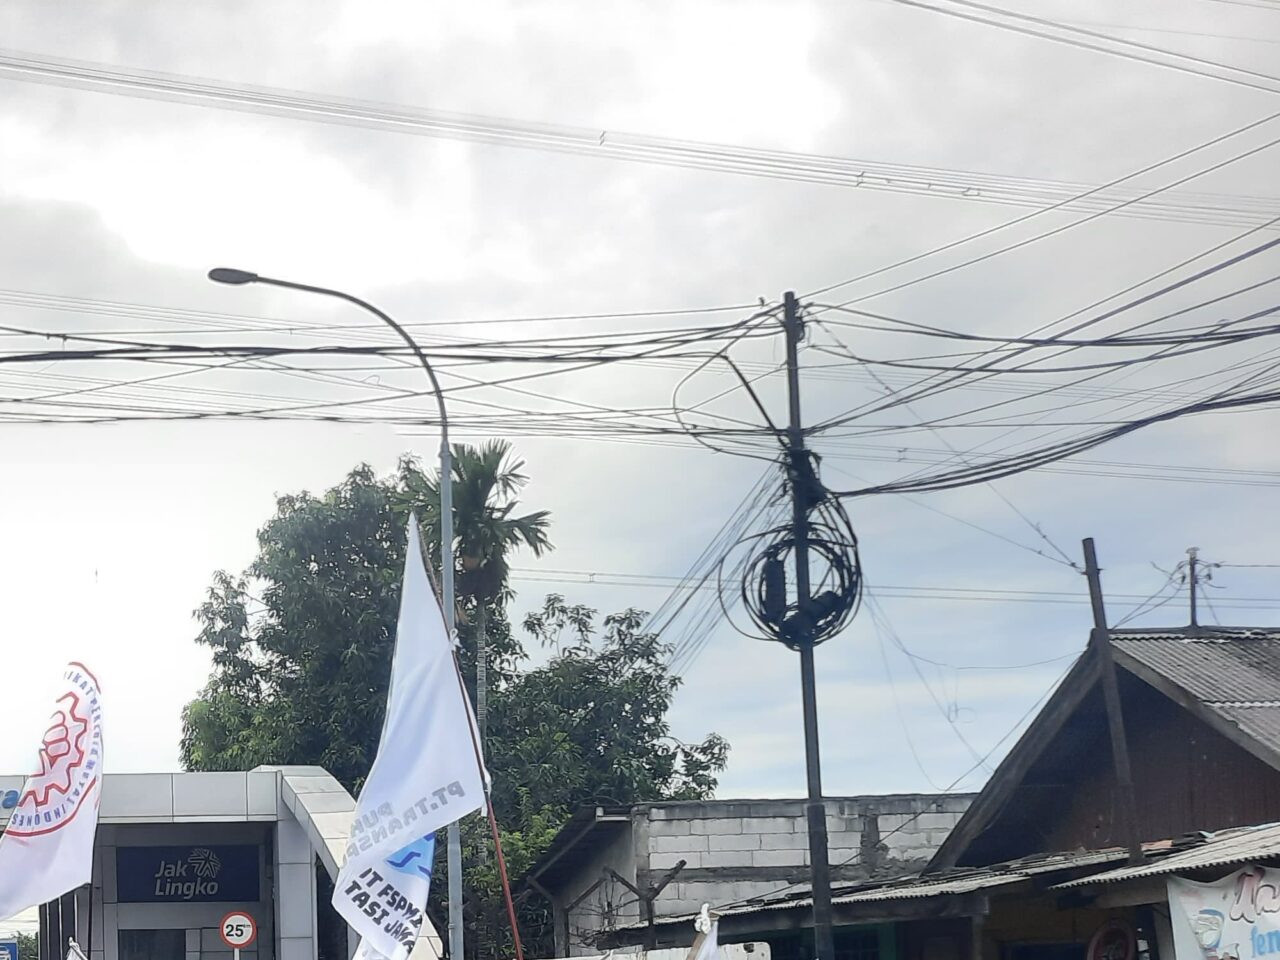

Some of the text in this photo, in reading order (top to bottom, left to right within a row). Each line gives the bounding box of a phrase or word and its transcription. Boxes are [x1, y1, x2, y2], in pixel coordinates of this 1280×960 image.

[154, 860, 188, 878] Jak
[154, 878, 219, 899] Lingko
[225, 924, 245, 937] 25
